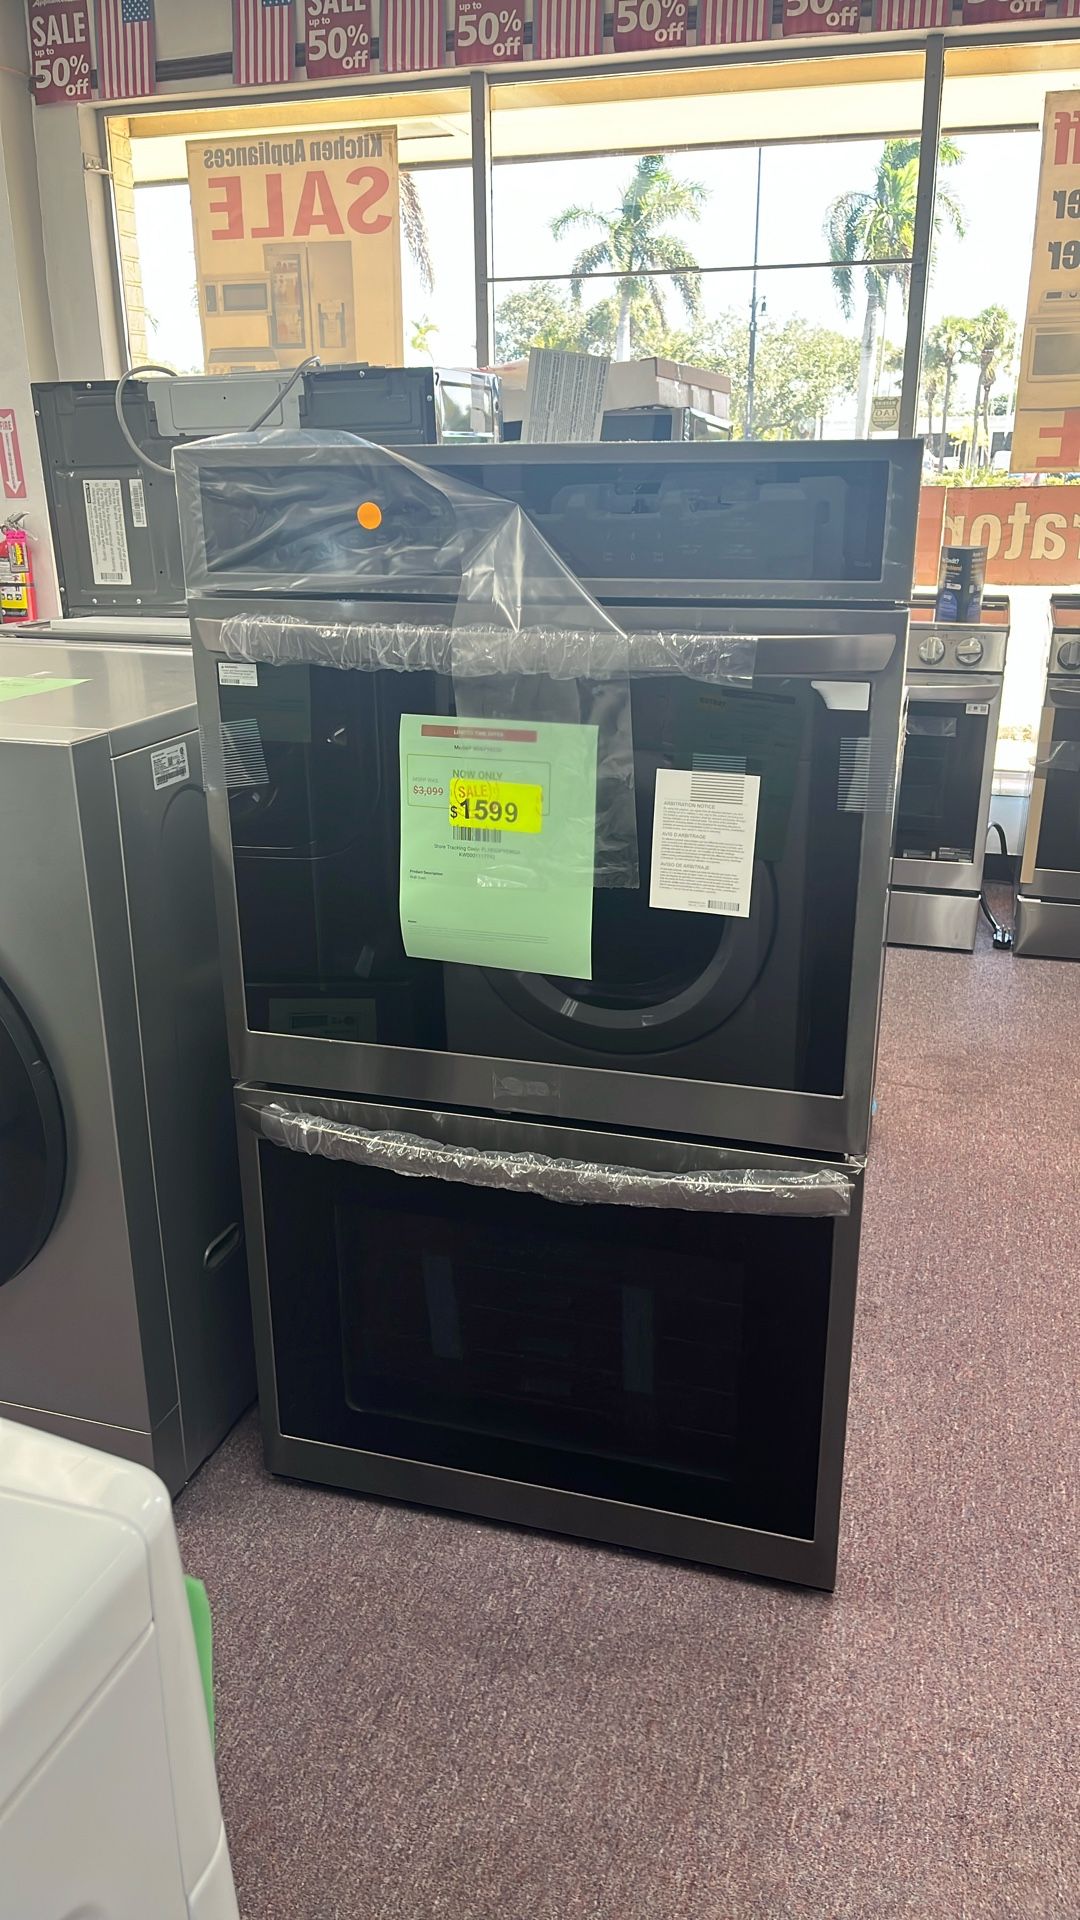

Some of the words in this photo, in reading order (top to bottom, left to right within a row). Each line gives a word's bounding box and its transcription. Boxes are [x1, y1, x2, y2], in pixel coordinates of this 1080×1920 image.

[459, 4, 470, 12] up
[472, 2, 482, 10] to
[826, 7, 858, 26] off
[32, 12, 86, 47] SALE
[309, 19, 319, 28] up
[458, 9, 521, 47] 50%
[654, 22, 684, 43] off
[309, 24, 368, 61] 50%
[492, 36, 521, 56] off
[35, 49, 45, 57] up
[342, 50, 368, 69] off
[35, 54, 89, 89] 50%
[65, 78, 88, 96] off
[452, 769, 475, 779] NOW
[479, 770, 503, 781] ONLY
[413, 785, 444, 797] $3,099
[458, 785, 489, 798] SALE
[450, 798, 519, 823] $1599
